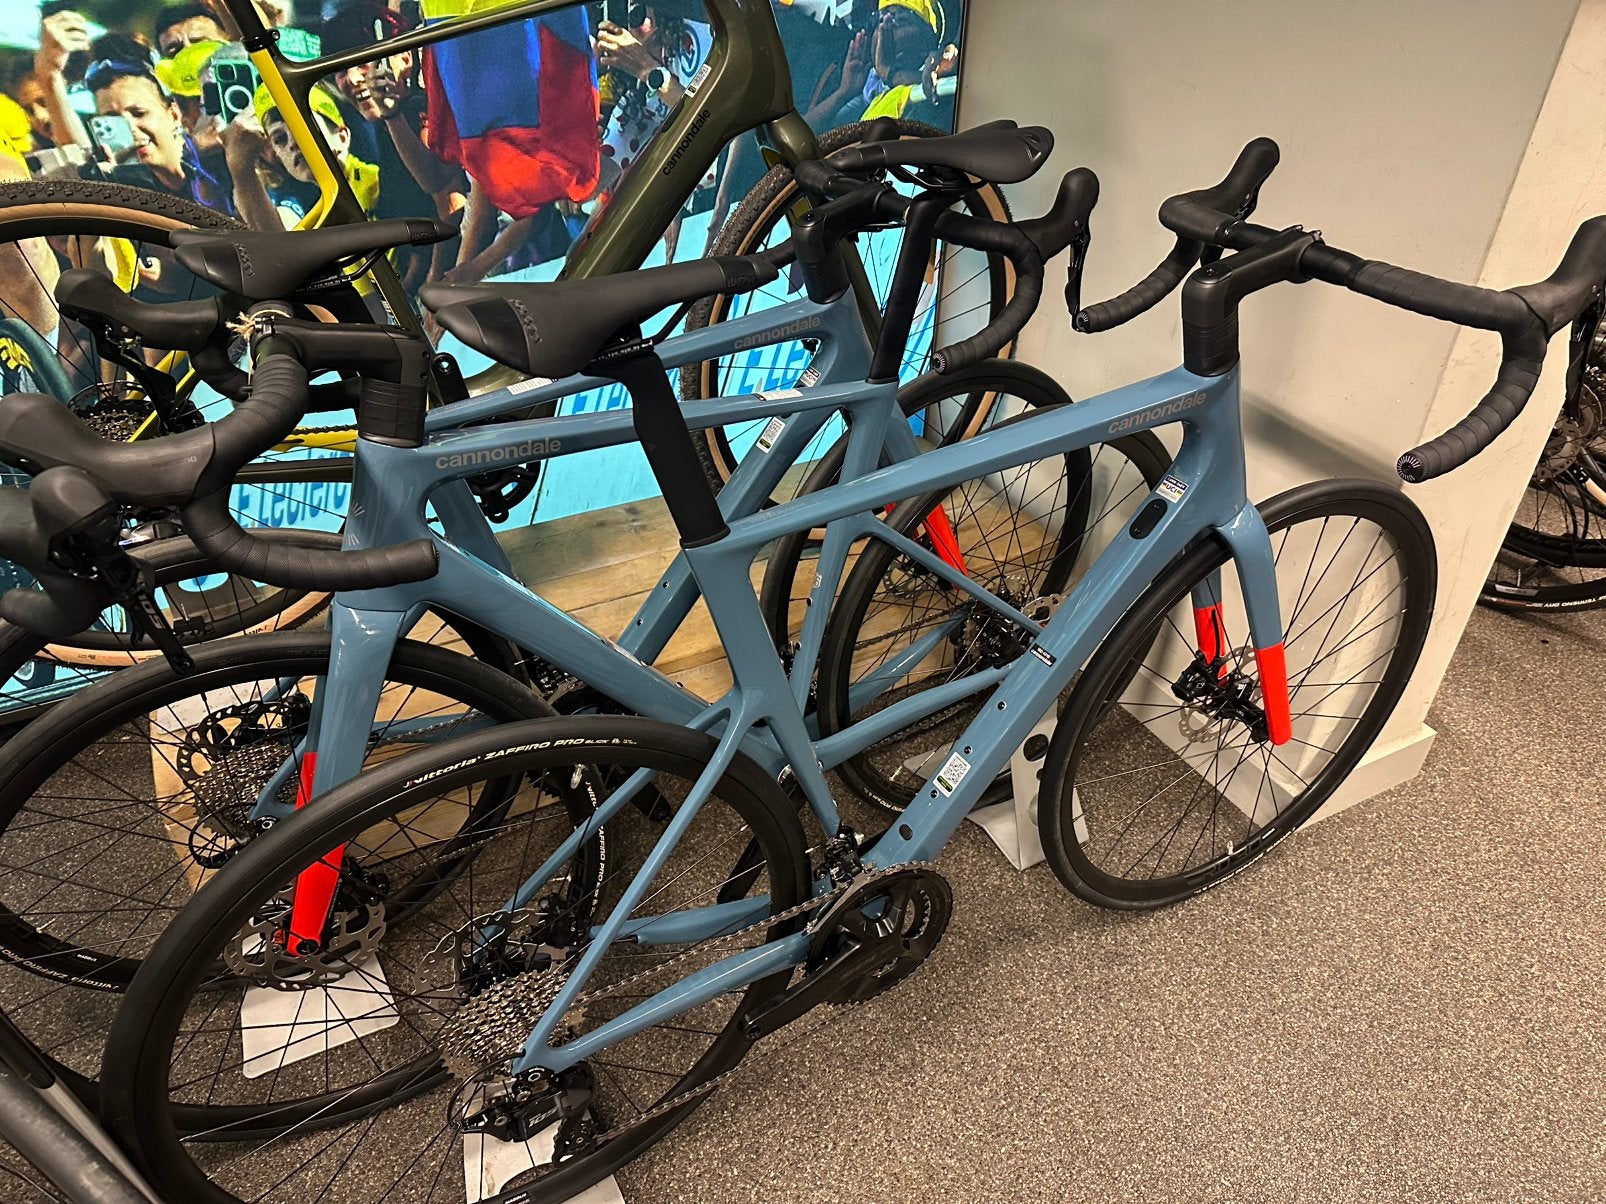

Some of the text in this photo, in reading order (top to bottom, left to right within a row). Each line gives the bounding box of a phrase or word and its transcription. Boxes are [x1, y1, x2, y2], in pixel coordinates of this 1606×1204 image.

[662, 108, 711, 176] cannondale
[734, 316, 821, 350] cannondale
[1108, 391, 1207, 433] cannondale
[435, 438, 562, 469] cannondale
[411, 756, 478, 785] vittoria
[483, 742, 550, 761] ZAFFIRO
[553, 738, 584, 747] PRO
